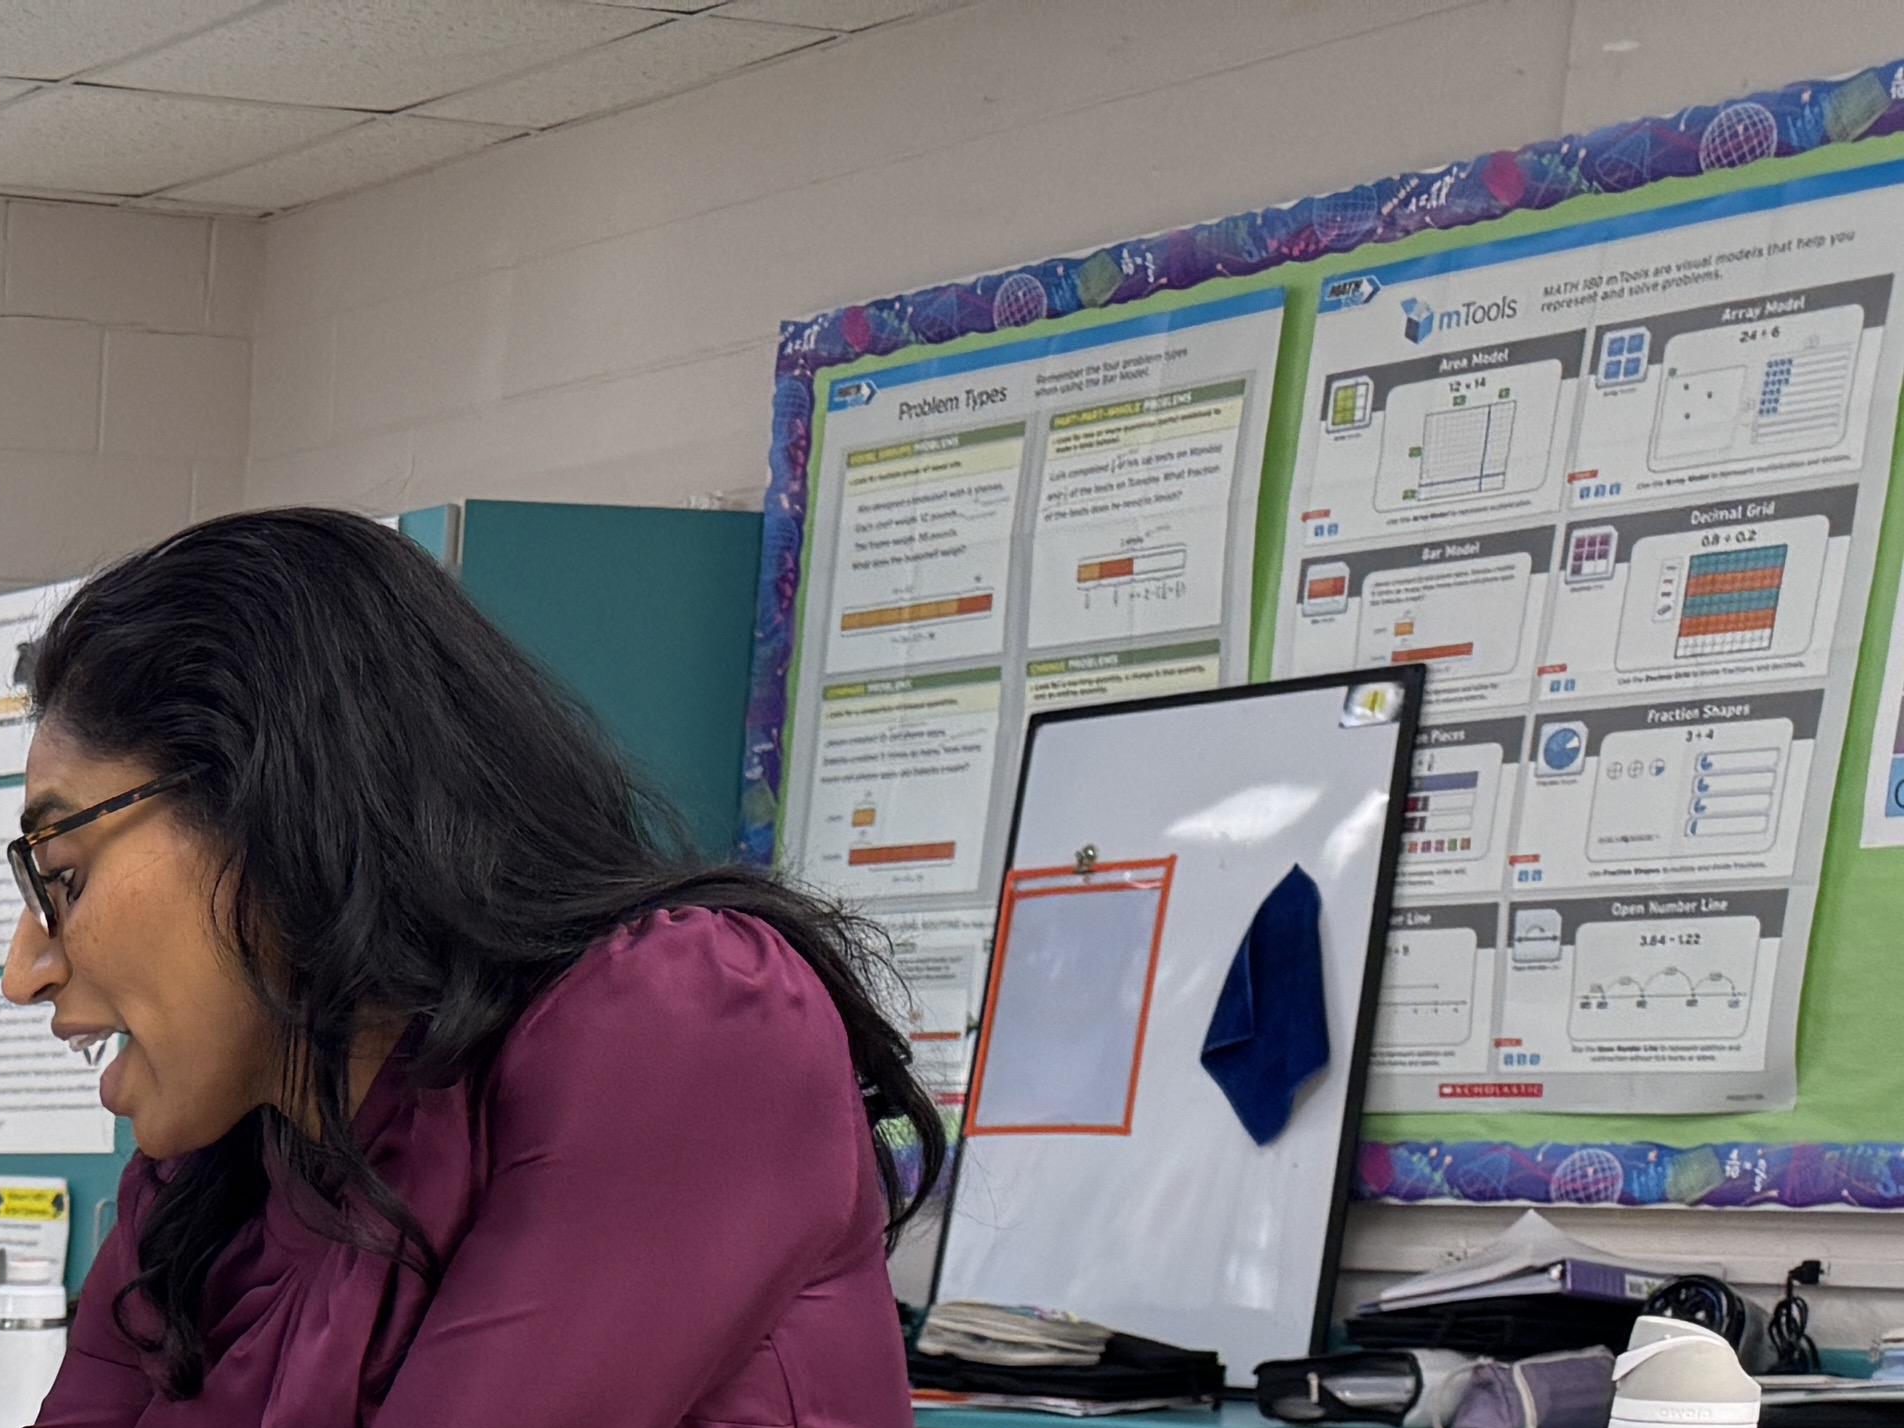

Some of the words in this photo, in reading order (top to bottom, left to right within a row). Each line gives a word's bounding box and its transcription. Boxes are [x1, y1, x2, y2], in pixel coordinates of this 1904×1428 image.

[1653, 264, 1672, 276] are
[1675, 256, 1713, 273] visual
[1715, 246, 1764, 267] models
[1767, 241, 1792, 257] that
[1796, 234, 1826, 251] help
[1830, 230, 1856, 248] you
[1541, 293, 1599, 313] represent
[1600, 287, 1625, 301] and
[1628, 281, 1660, 296] solve
[1721, 304, 1762, 323] Array
[1764, 296, 1806, 315] Model
[1438, 296, 1517, 331] mTools
[1438, 357, 1469, 373] Area
[1471, 349, 1509, 367] Model
[898, 394, 959, 420] Problem
[964, 386, 1008, 411] Types
[1690, 504, 1742, 526] Decimal
[1745, 500, 1776, 520] Grid
[1421, 546, 1443, 561] Bar
[1444, 541, 1480, 558] Model
[1647, 706, 1700, 723] Fraction
[1702, 703, 1750, 719] Shapes
[1611, 902, 1645, 916] Open
[1649, 899, 1698, 914] Number
[1700, 897, 1728, 912] Line
